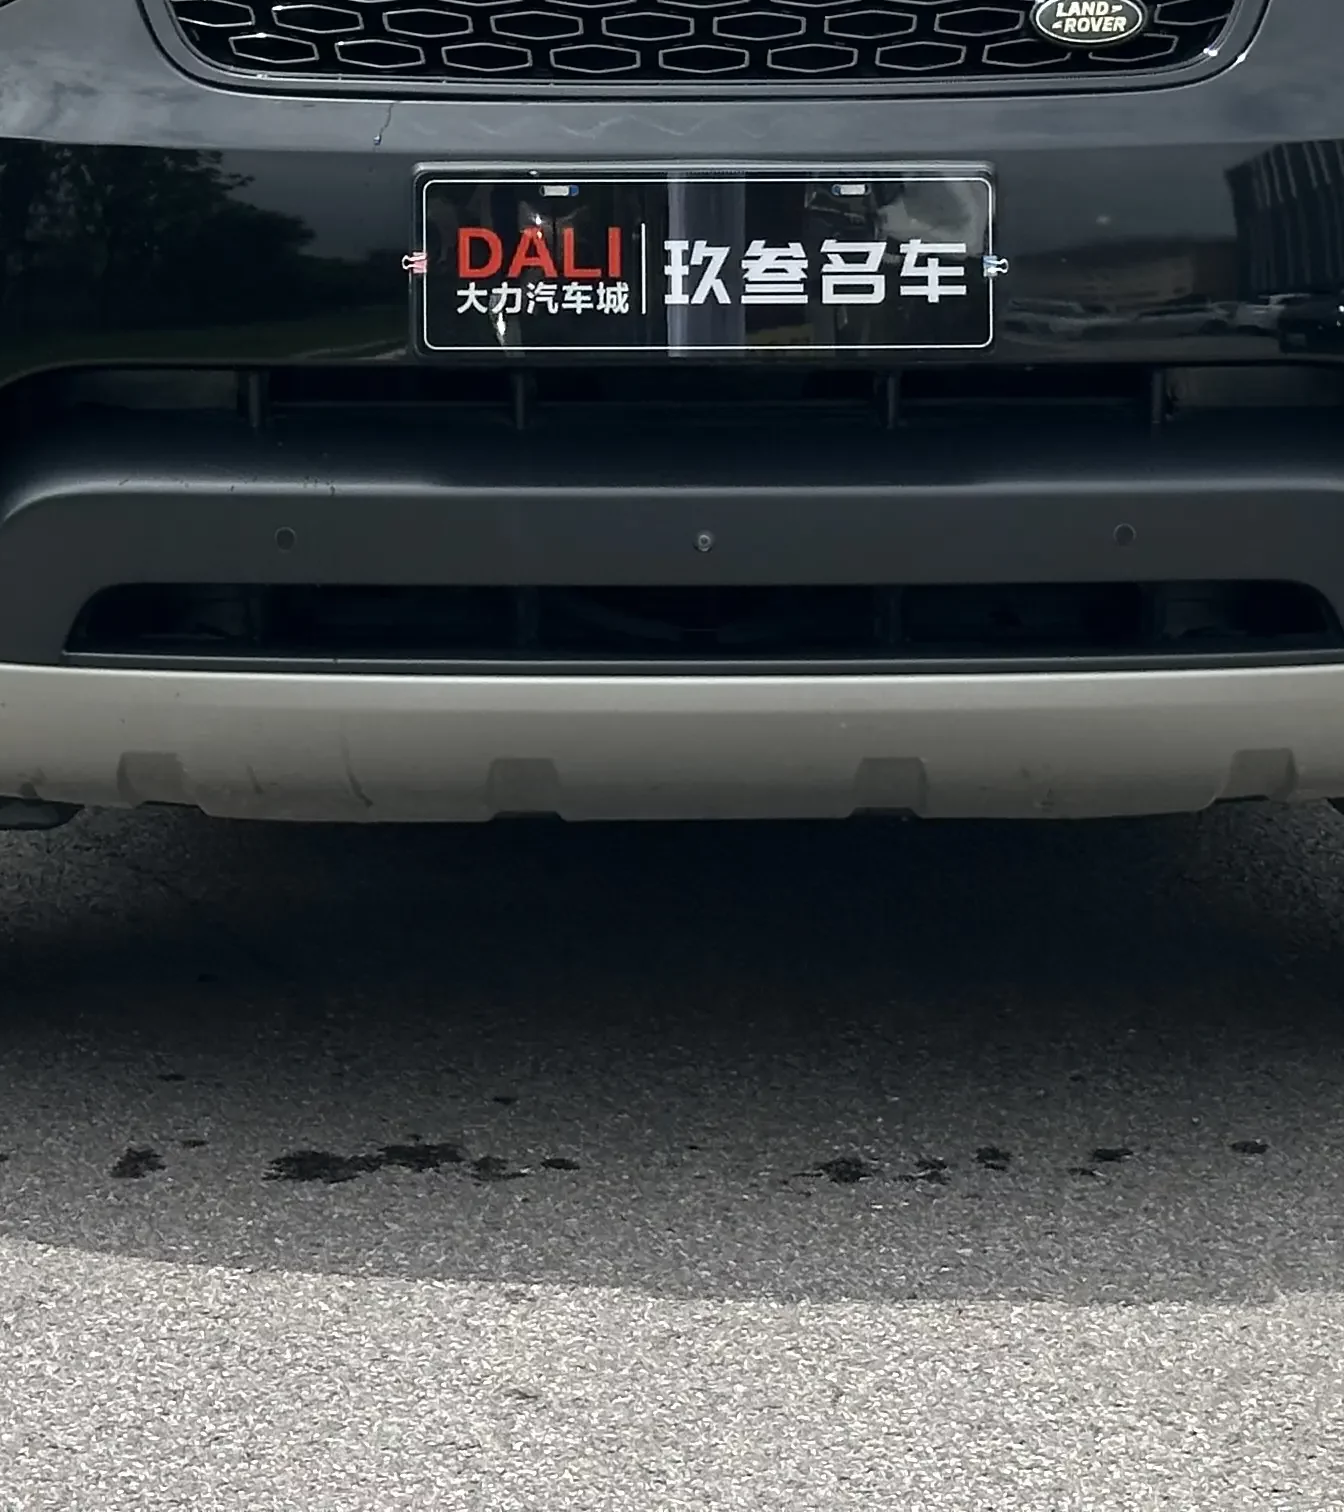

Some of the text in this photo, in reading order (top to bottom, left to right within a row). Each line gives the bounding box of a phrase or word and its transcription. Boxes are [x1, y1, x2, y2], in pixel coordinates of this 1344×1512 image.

[1056, 1, 1109, 17] LAND
[1064, 16, 1127, 33] ROVER
[457, 226, 622, 278] DALI
[663, 238, 968, 305] 玖叁名车
[457, 281, 630, 315] 大力汽车城
